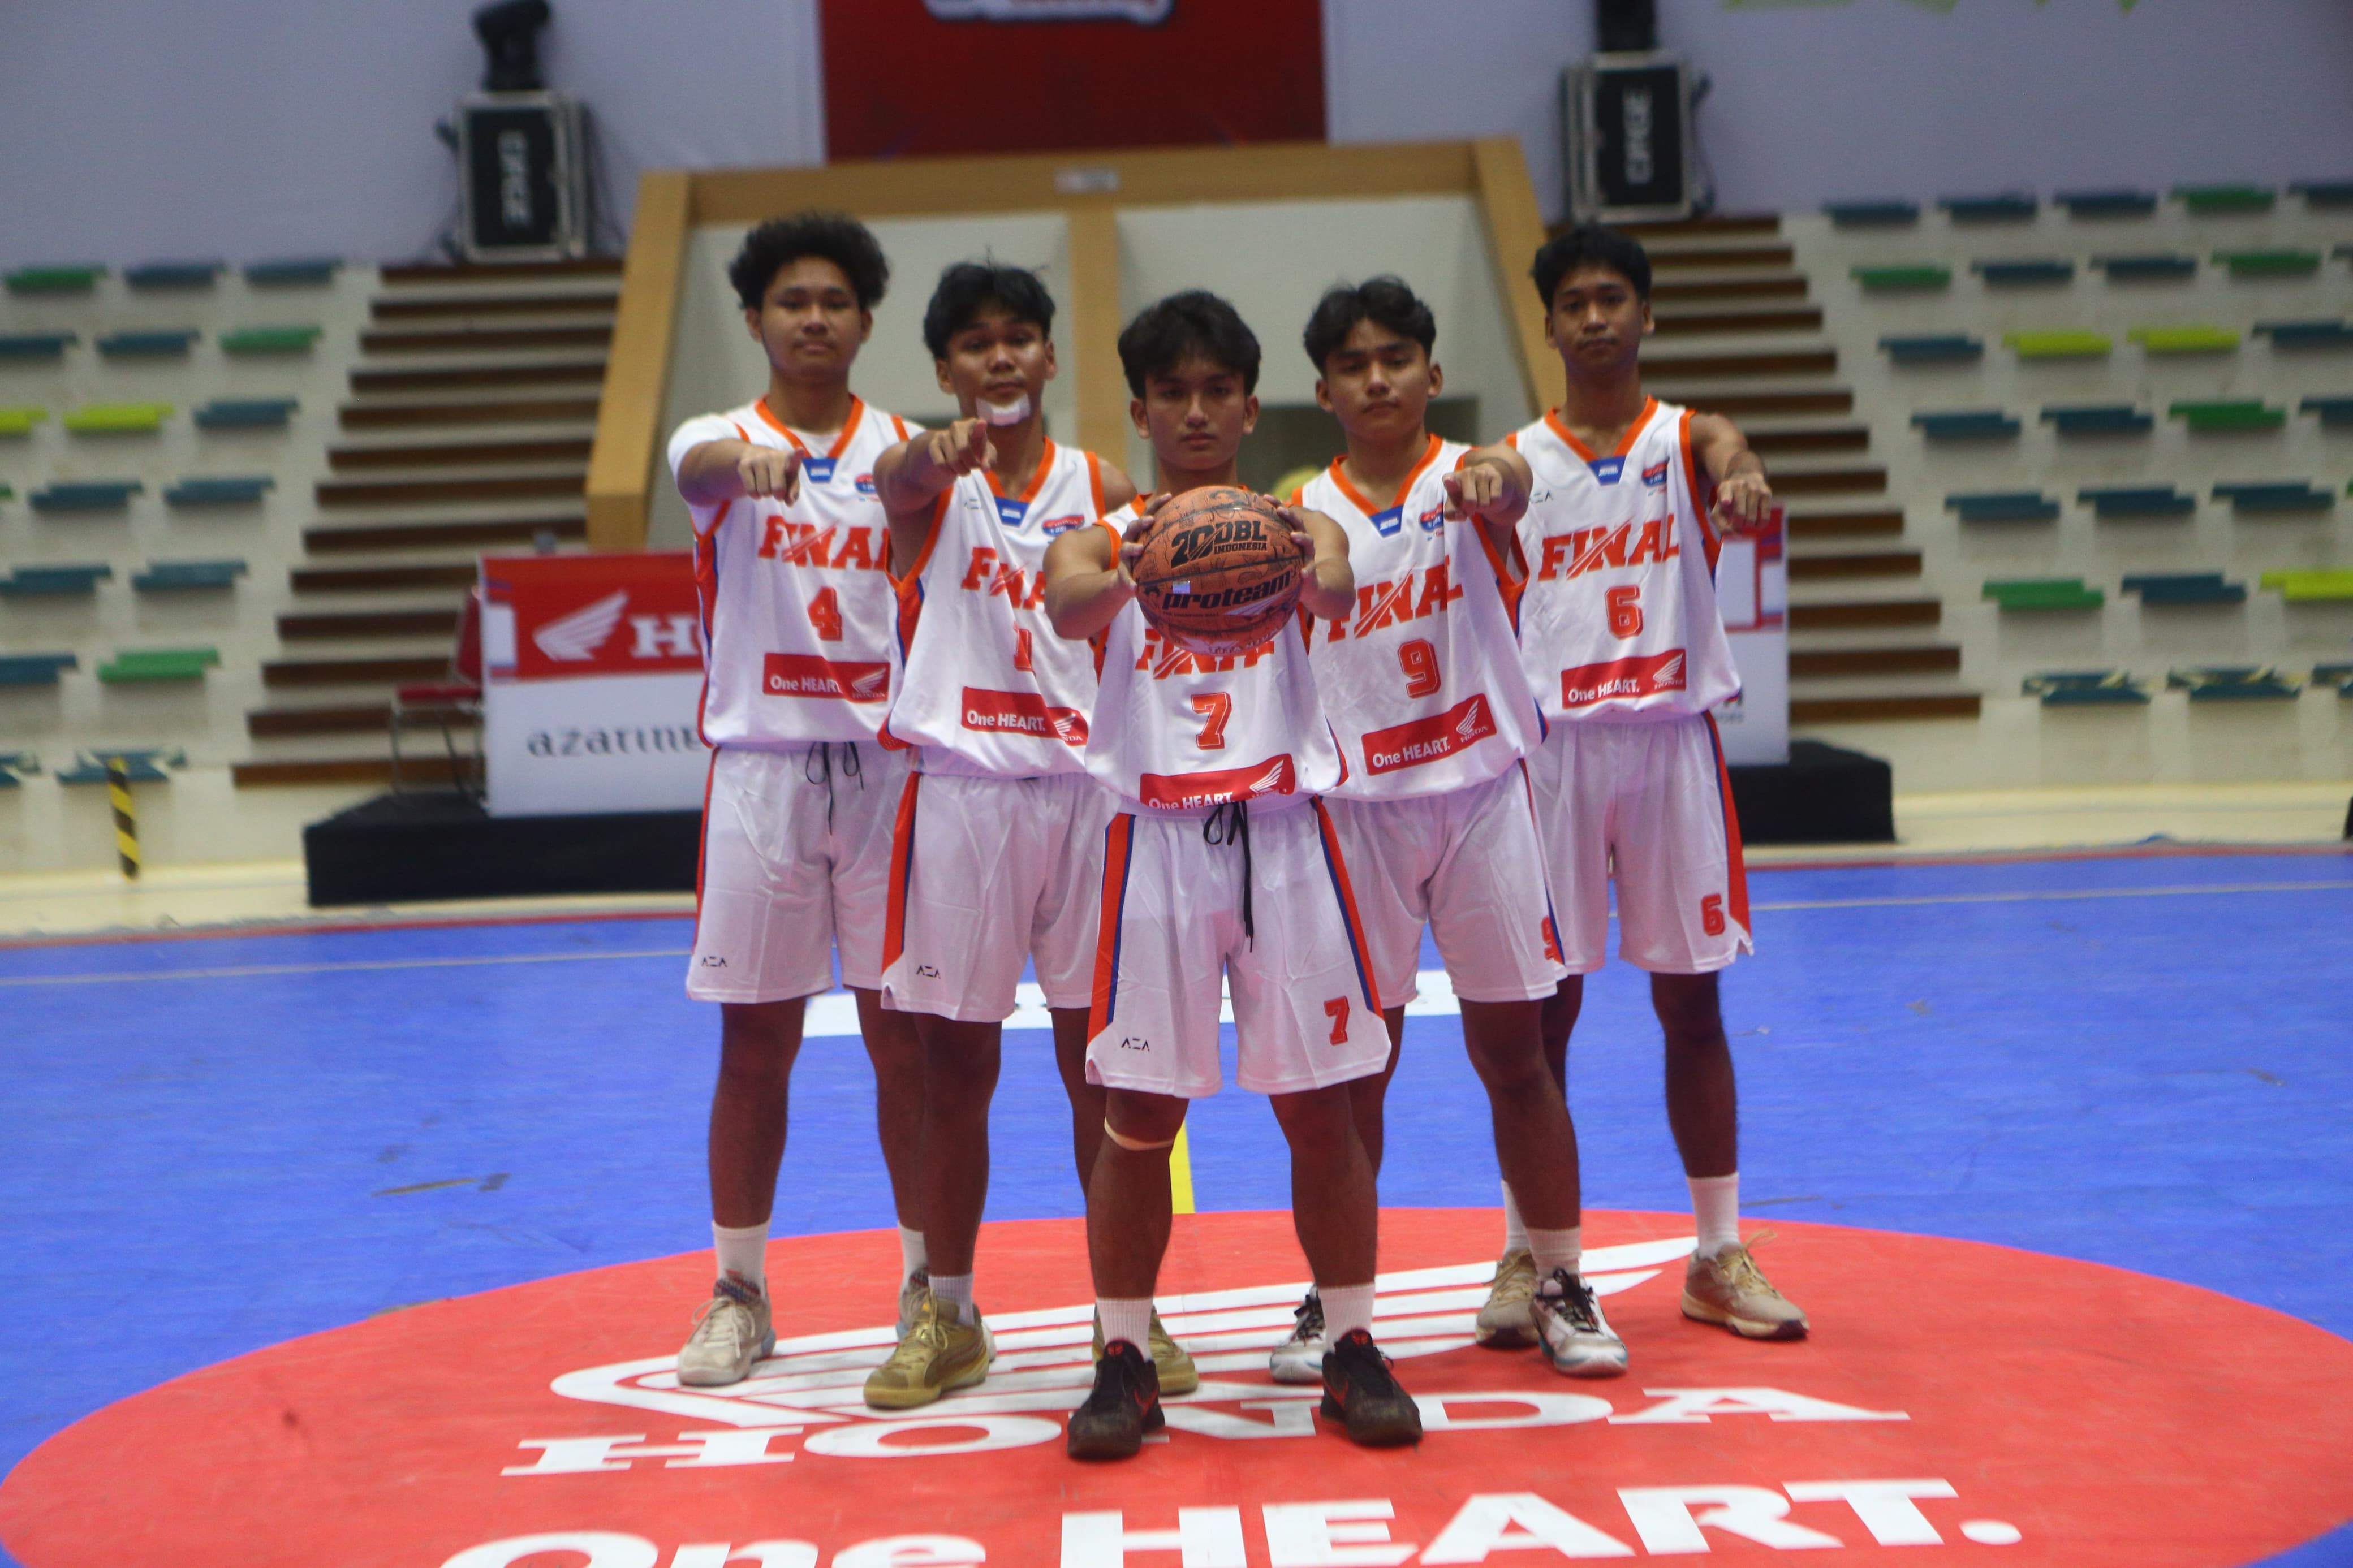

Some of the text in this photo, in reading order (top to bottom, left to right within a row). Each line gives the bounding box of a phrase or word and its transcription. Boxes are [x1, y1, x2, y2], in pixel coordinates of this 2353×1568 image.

[1214, 542, 1267, 554] INDONESIA
[1538, 513, 1679, 582] FINAL
[1162, 570, 1291, 610] proteam
[1604, 585, 1643, 640] 6
[808, 587, 843, 642] 4
[770, 675, 798, 690] One
[1397, 639, 1441, 699] 9
[1568, 678, 1640, 703] One HEART.
[967, 710, 1045, 731] One HEART.
[1191, 692, 1232, 750] 7
[1373, 736, 1451, 768] One HEART.
[1700, 892, 1725, 937] 6
[1323, 995, 1350, 1046] 7
[1059, 1478, 2023, 1568] HEART.
